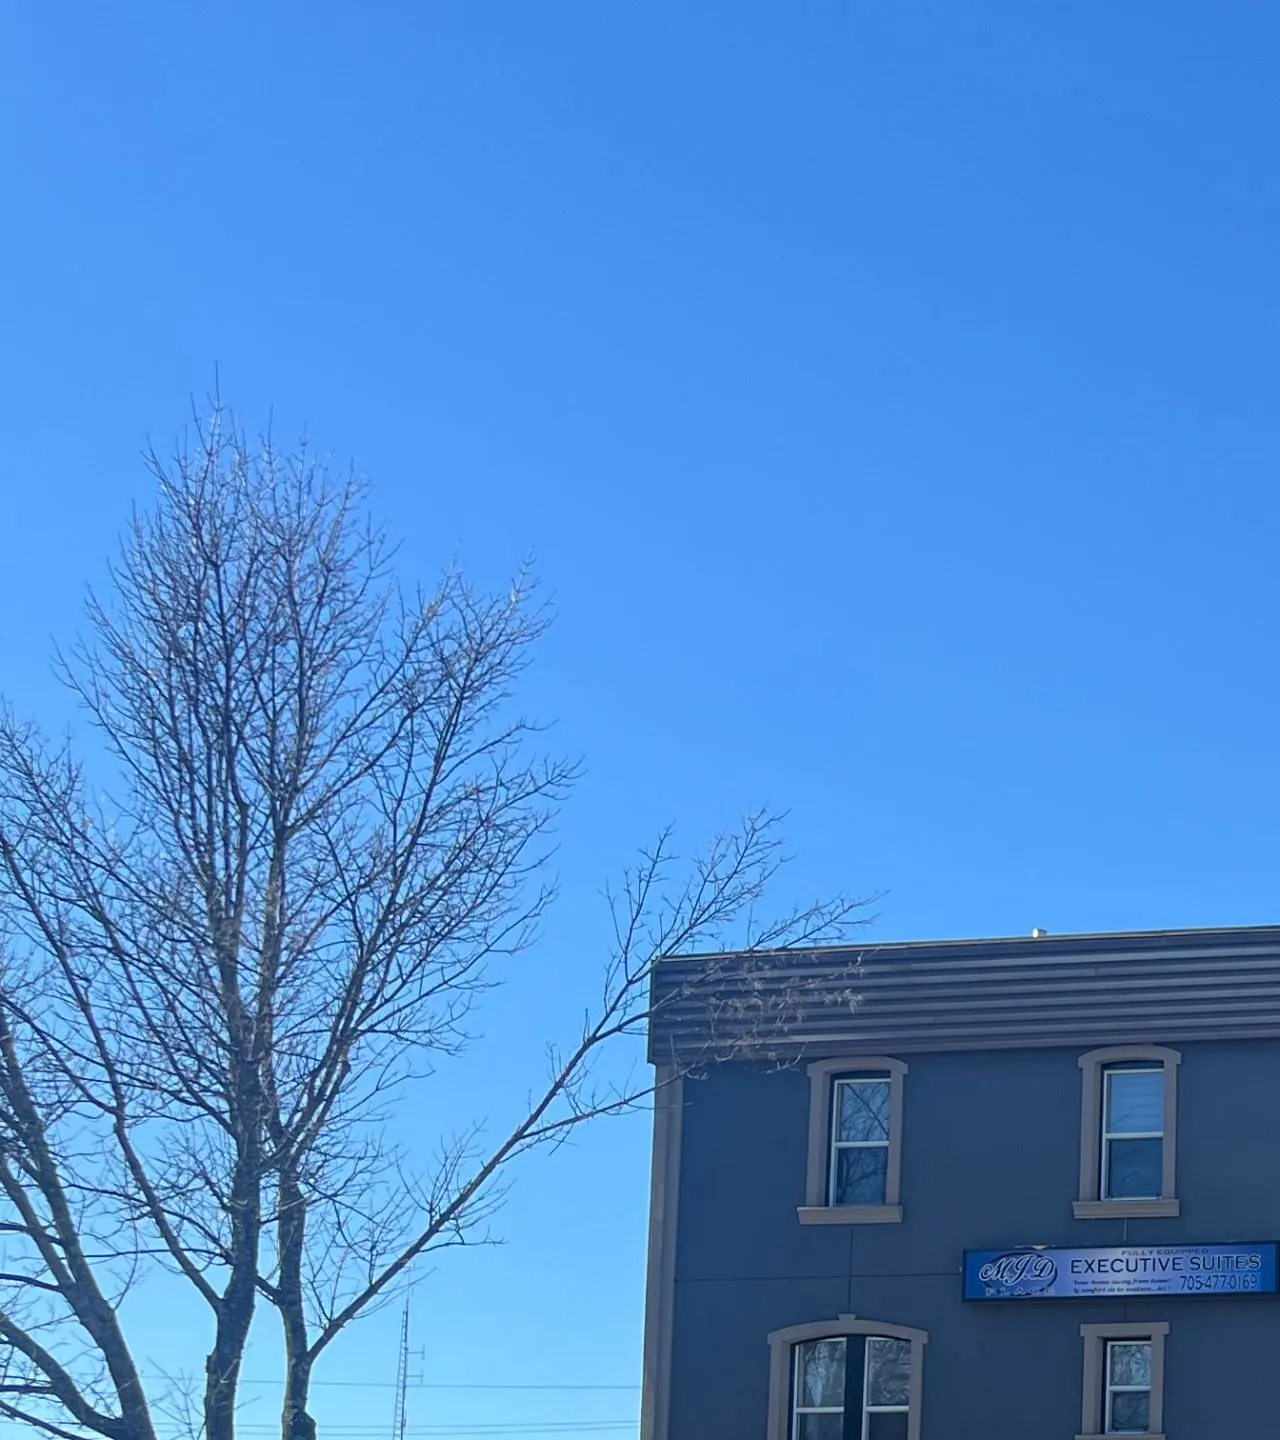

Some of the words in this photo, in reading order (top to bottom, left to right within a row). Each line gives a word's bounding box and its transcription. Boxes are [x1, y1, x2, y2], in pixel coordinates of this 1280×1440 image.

[1070, 1256, 1184, 1274] EXECUTIVE
[1189, 1254, 1262, 1271] SUITES
[1179, 1273, 1258, 1291] 705-477-0169
